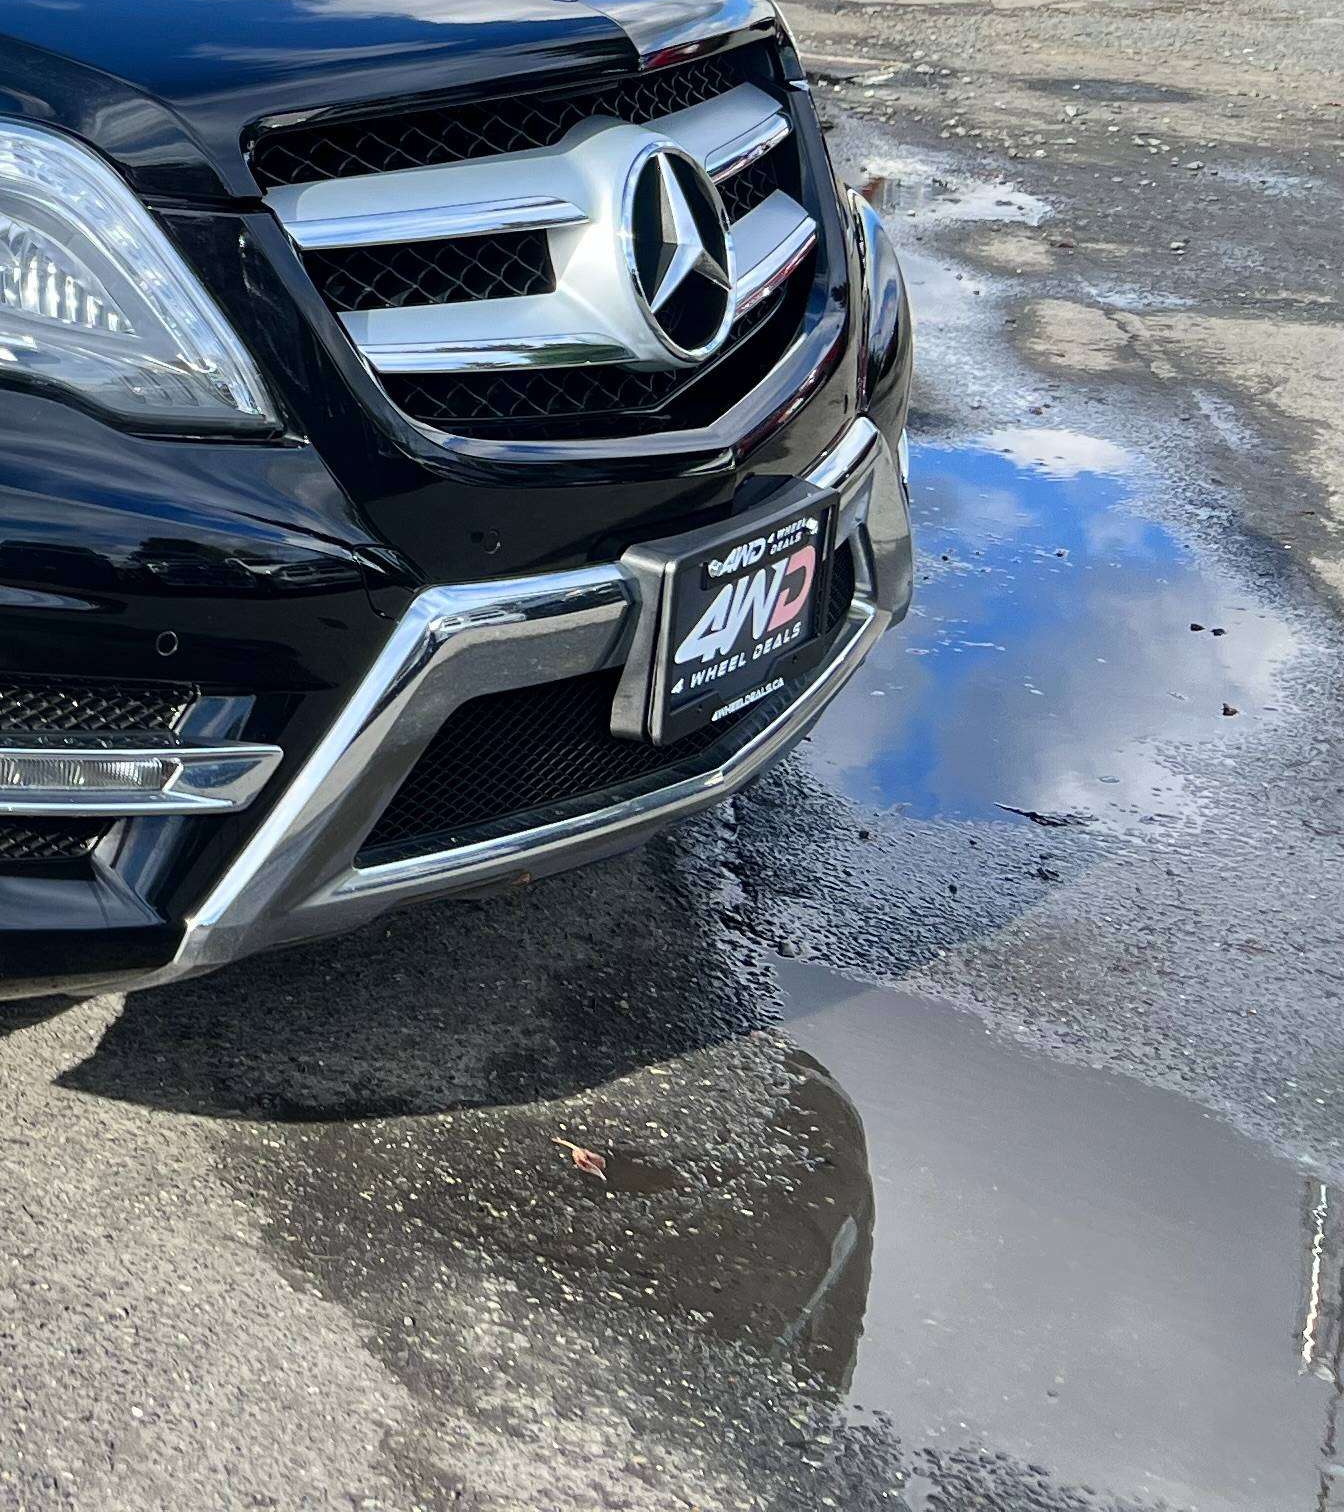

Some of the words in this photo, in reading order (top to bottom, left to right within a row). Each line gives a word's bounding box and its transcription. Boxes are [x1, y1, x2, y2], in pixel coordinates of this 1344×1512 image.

[674, 544, 816, 664] 4WD
[670, 678, 685, 694] 4
[690, 652, 747, 688] WHEEL
[752, 621, 802, 660] DEALS
